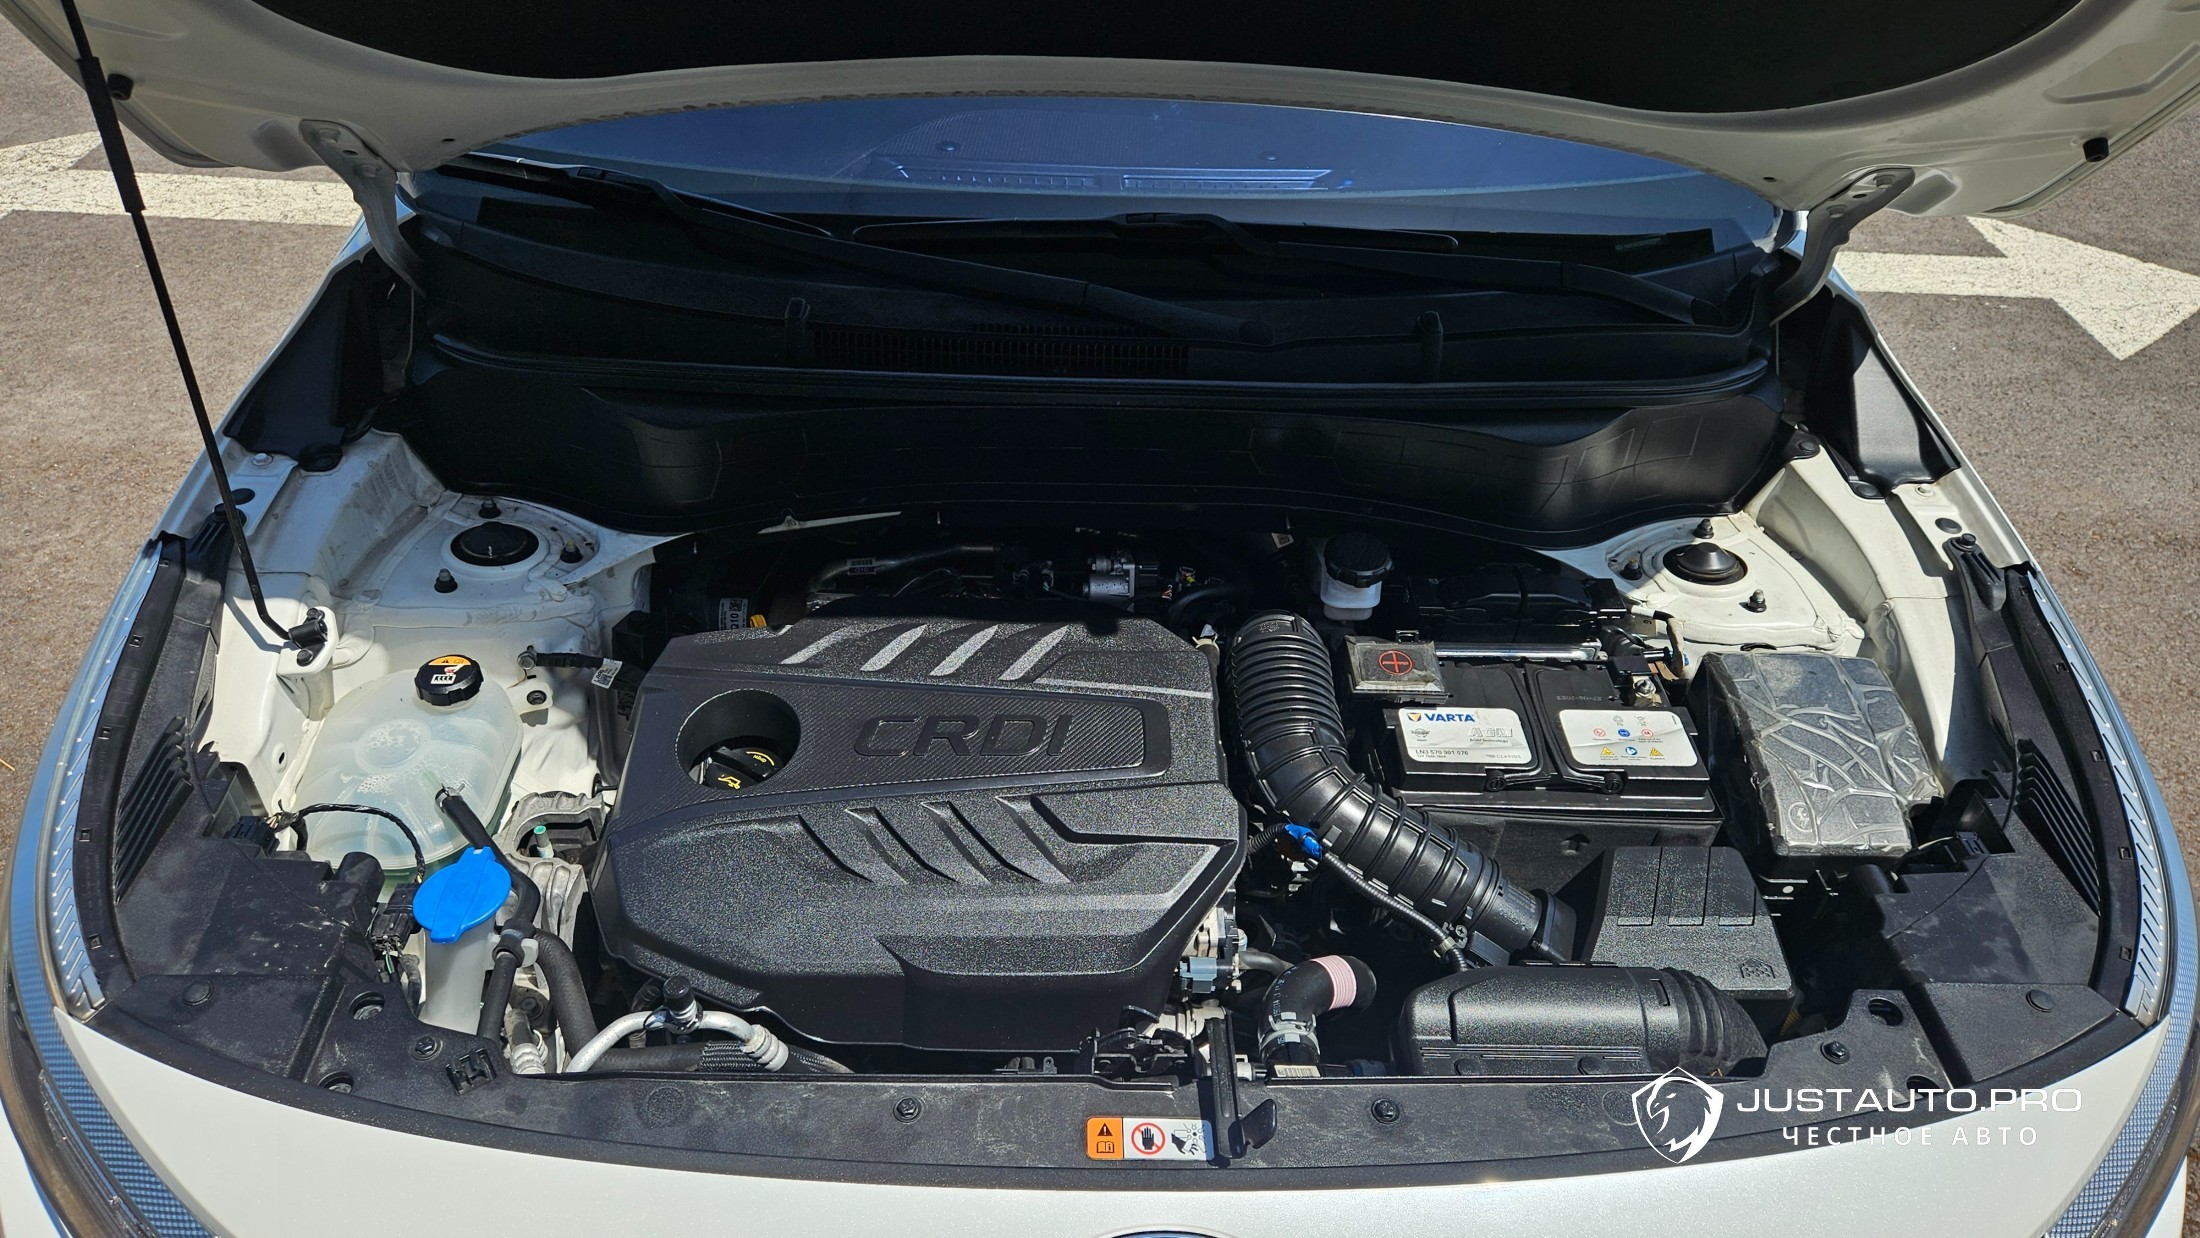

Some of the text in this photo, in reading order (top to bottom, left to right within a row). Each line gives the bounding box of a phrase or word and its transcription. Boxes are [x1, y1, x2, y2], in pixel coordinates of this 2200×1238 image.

[1425, 713, 1475, 722] VARTA
[854, 714, 1073, 757] CRDI
[1468, 727, 1513, 738] AGM
